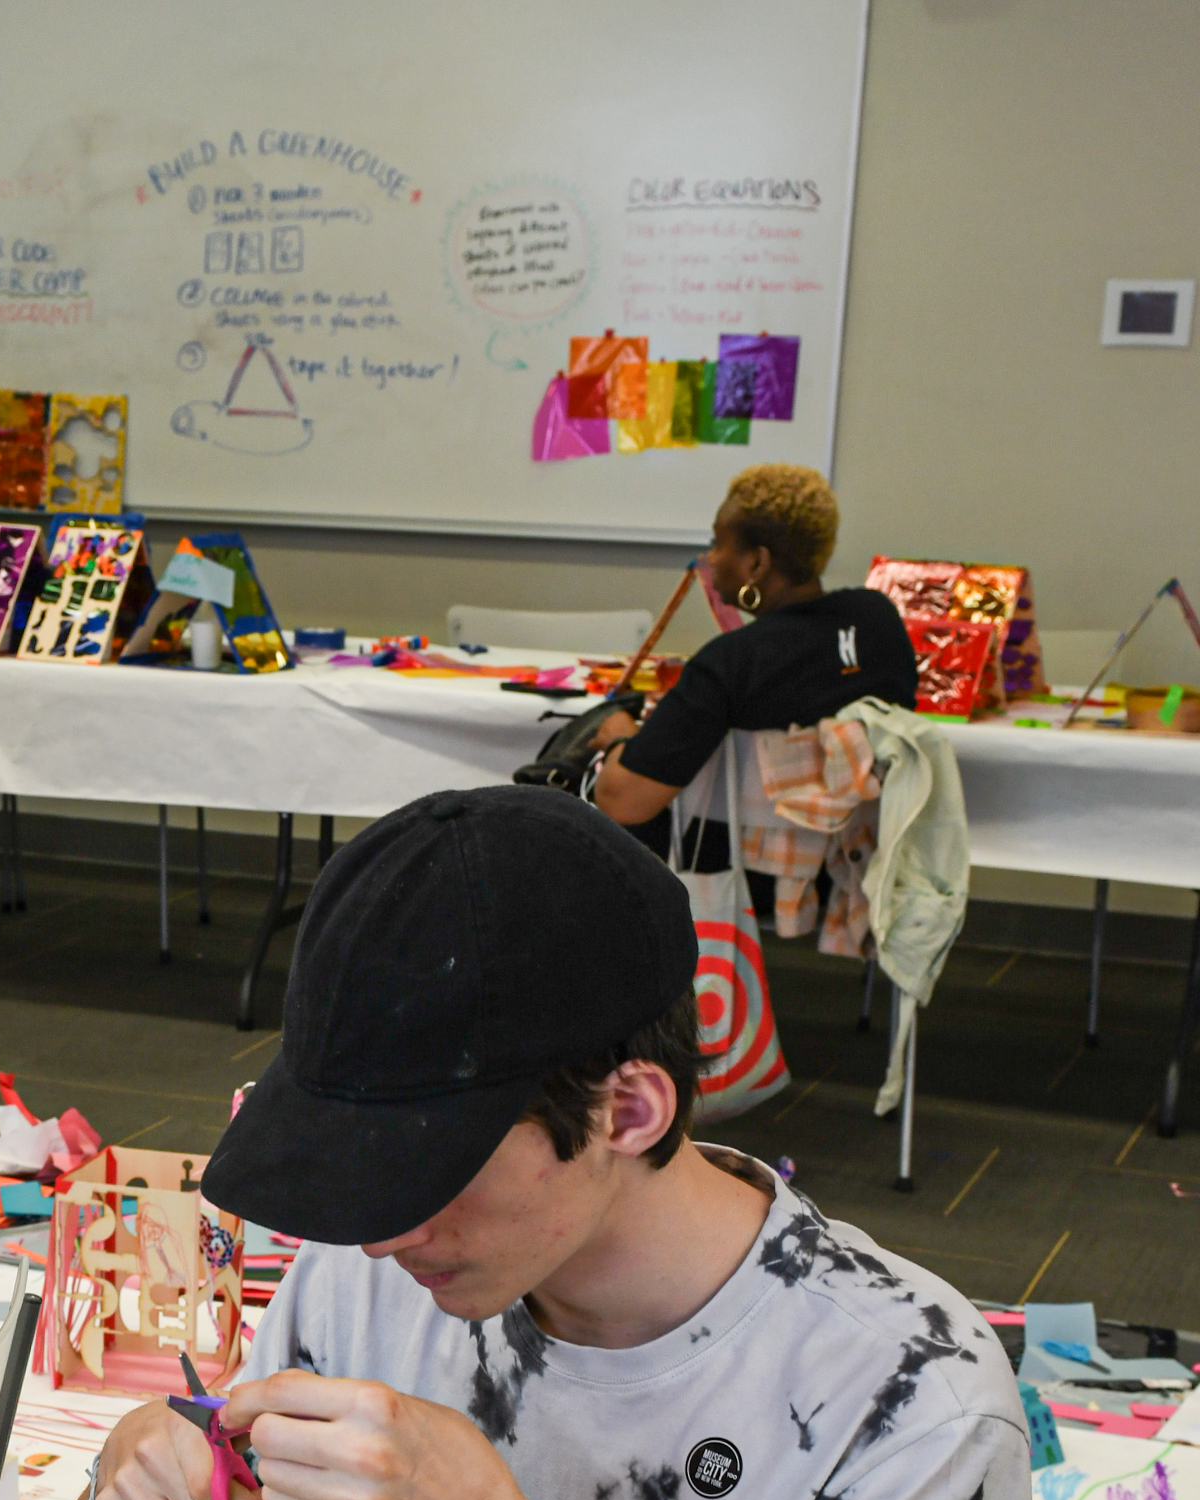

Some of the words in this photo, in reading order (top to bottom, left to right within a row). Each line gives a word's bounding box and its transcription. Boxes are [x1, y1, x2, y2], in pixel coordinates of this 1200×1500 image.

[228, 130, 246, 158] A
[288, 356, 327, 382] tape
[336, 355, 352, 377] it
[703, 1449, 731, 1468] MUSEUM
[703, 1461, 728, 1481] CITY
